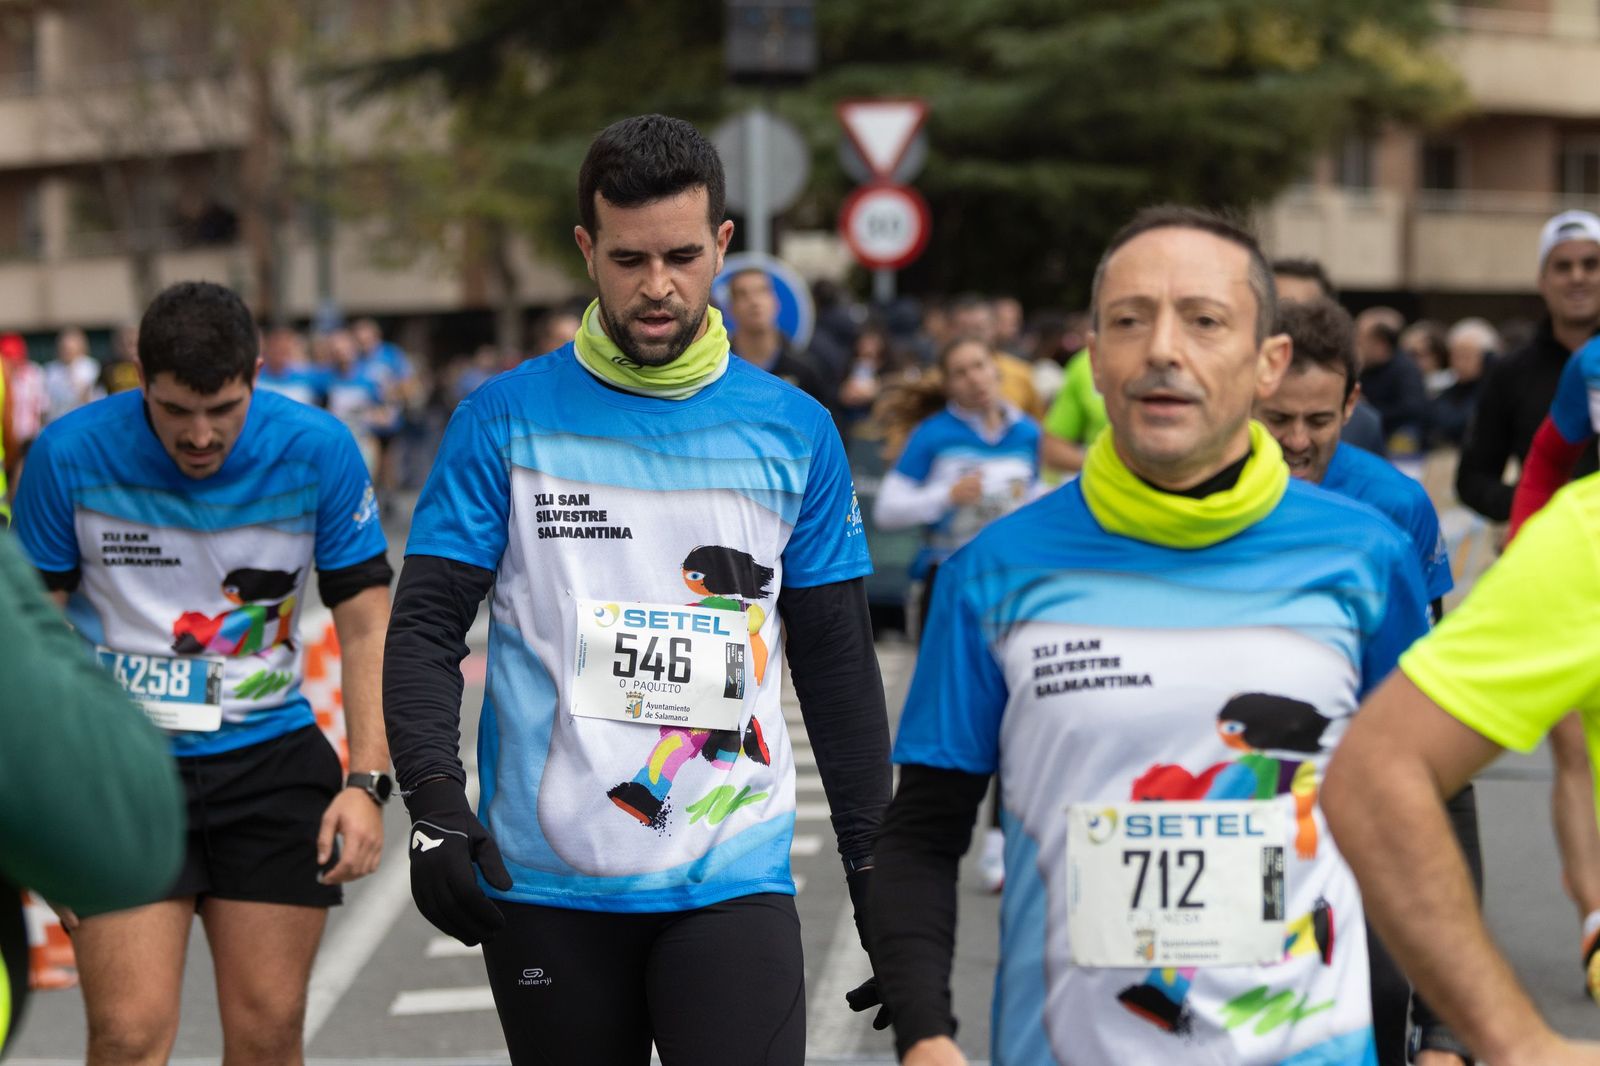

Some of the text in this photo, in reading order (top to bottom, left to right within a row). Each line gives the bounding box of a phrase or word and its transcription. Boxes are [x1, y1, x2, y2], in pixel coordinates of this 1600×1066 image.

[534, 494, 590, 507] XLI SAN
[536, 510, 607, 523] SILVESTRE
[124, 532, 149, 542] SAN
[537, 526, 633, 539] SALMANTINA
[102, 545, 162, 556] SILVESTRE
[102, 557, 182, 567] SALMANTINA
[624, 609, 730, 636] SETEL
[1065, 639, 1101, 653] SAN
[613, 632, 692, 684] 546
[1034, 657, 1121, 679] SILVESTRE
[113, 653, 191, 697] 4258
[633, 680, 682, 694] PAQUITO
[1036, 674, 1153, 697] SALMANTINA
[645, 701, 691, 713] Ayuntamiento
[644, 712, 689, 722] de Salamanca
[1124, 814, 1265, 838] SETEL
[1122, 849, 1206, 909] 712
[518, 977, 552, 986] Kalenji
